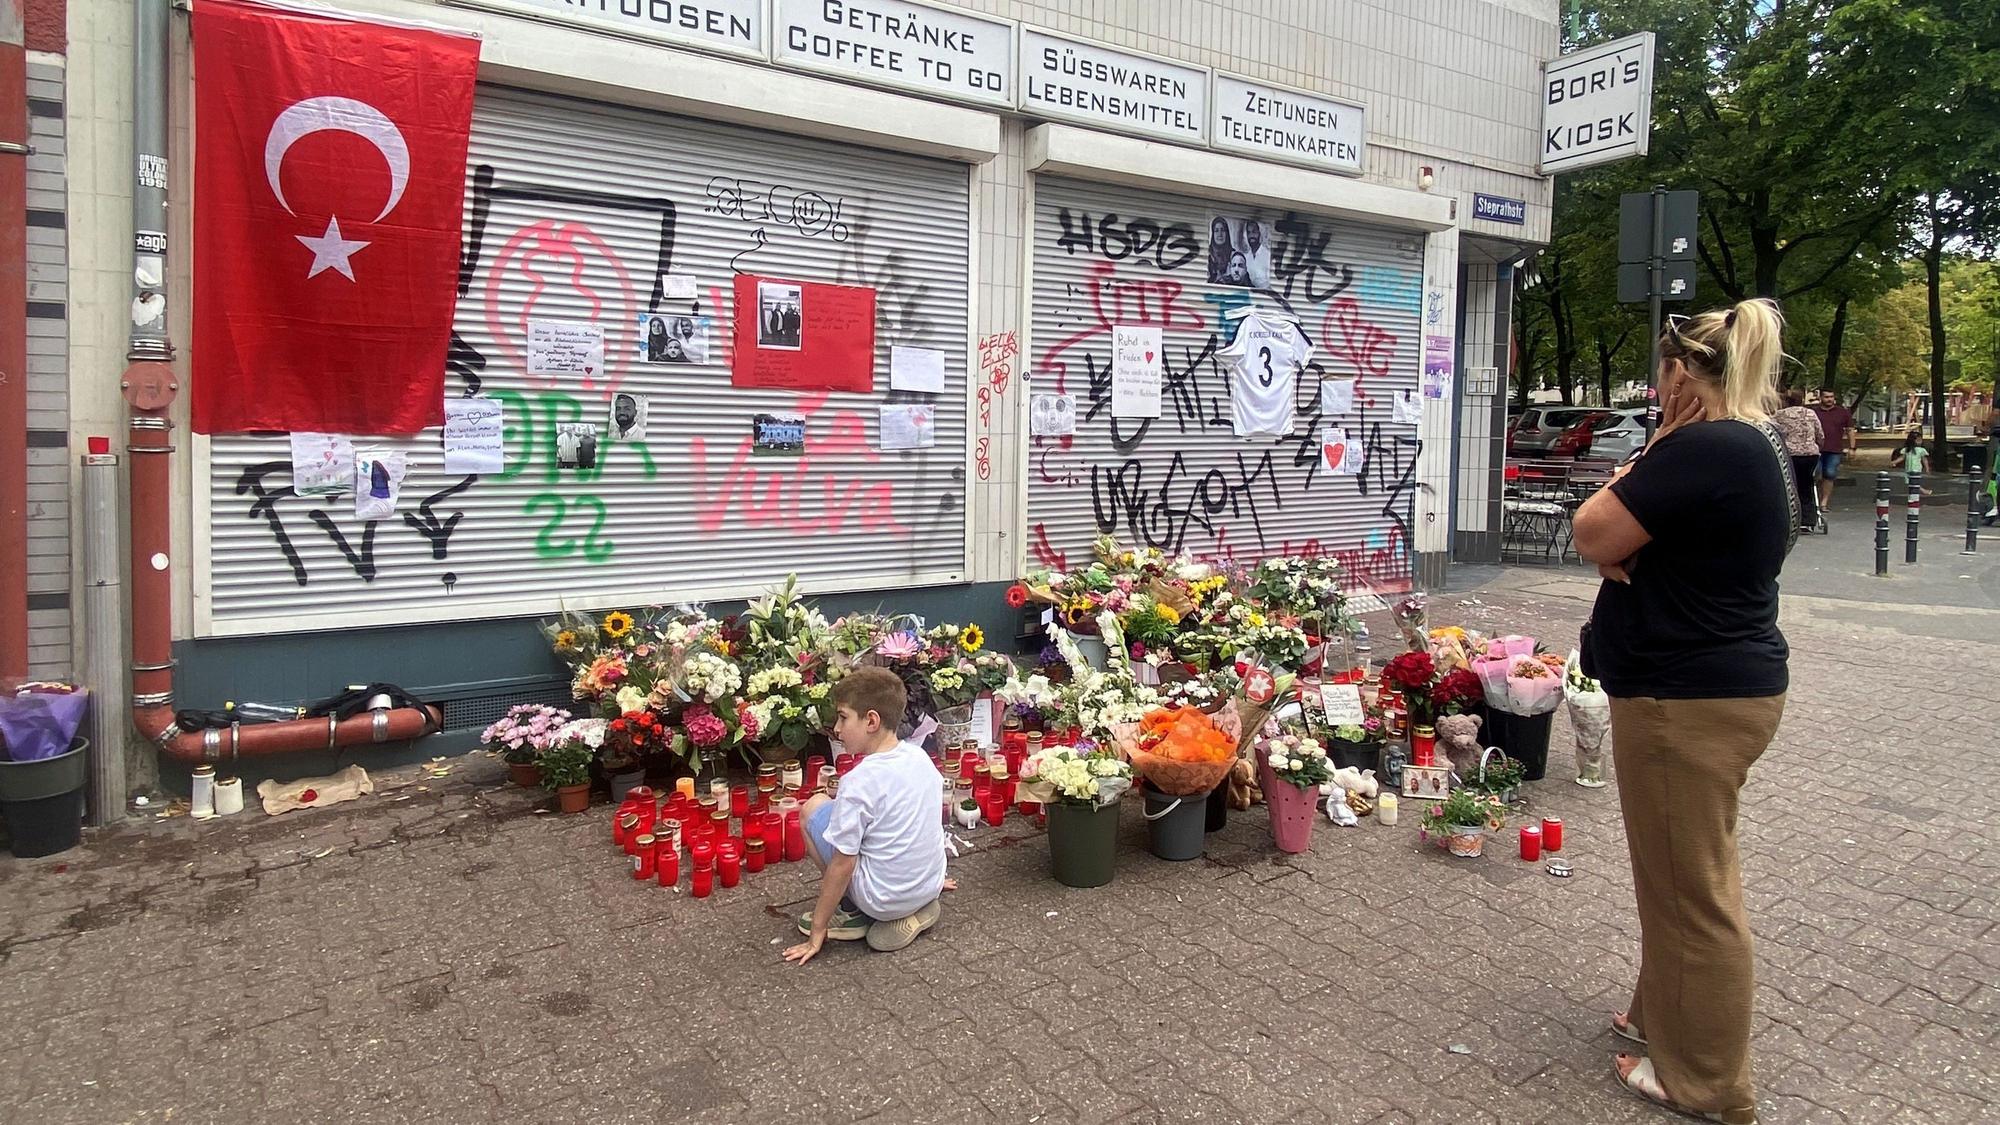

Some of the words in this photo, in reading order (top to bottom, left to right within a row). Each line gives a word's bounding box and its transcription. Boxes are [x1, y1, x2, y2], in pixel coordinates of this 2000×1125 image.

[564, 0, 751, 41] UOSEN
[823, 0, 975, 55] GETRÄNKE
[788, 25, 903, 73] COFFEE
[919, 57, 953, 83] TO
[968, 70, 1002, 93] GO
[1042, 47, 1187, 99] SÜSSWAREN
[1028, 75, 1199, 132] LEBENSMITTEL
[1245, 91, 1339, 130] ZEITUNGEN
[1221, 115, 1357, 161] TELEFONKARTEN
[1545, 111, 1635, 154] KIOSK
[1477, 196, 1524, 219] Steprathstr.
[1258, 346, 1274, 388] 3
